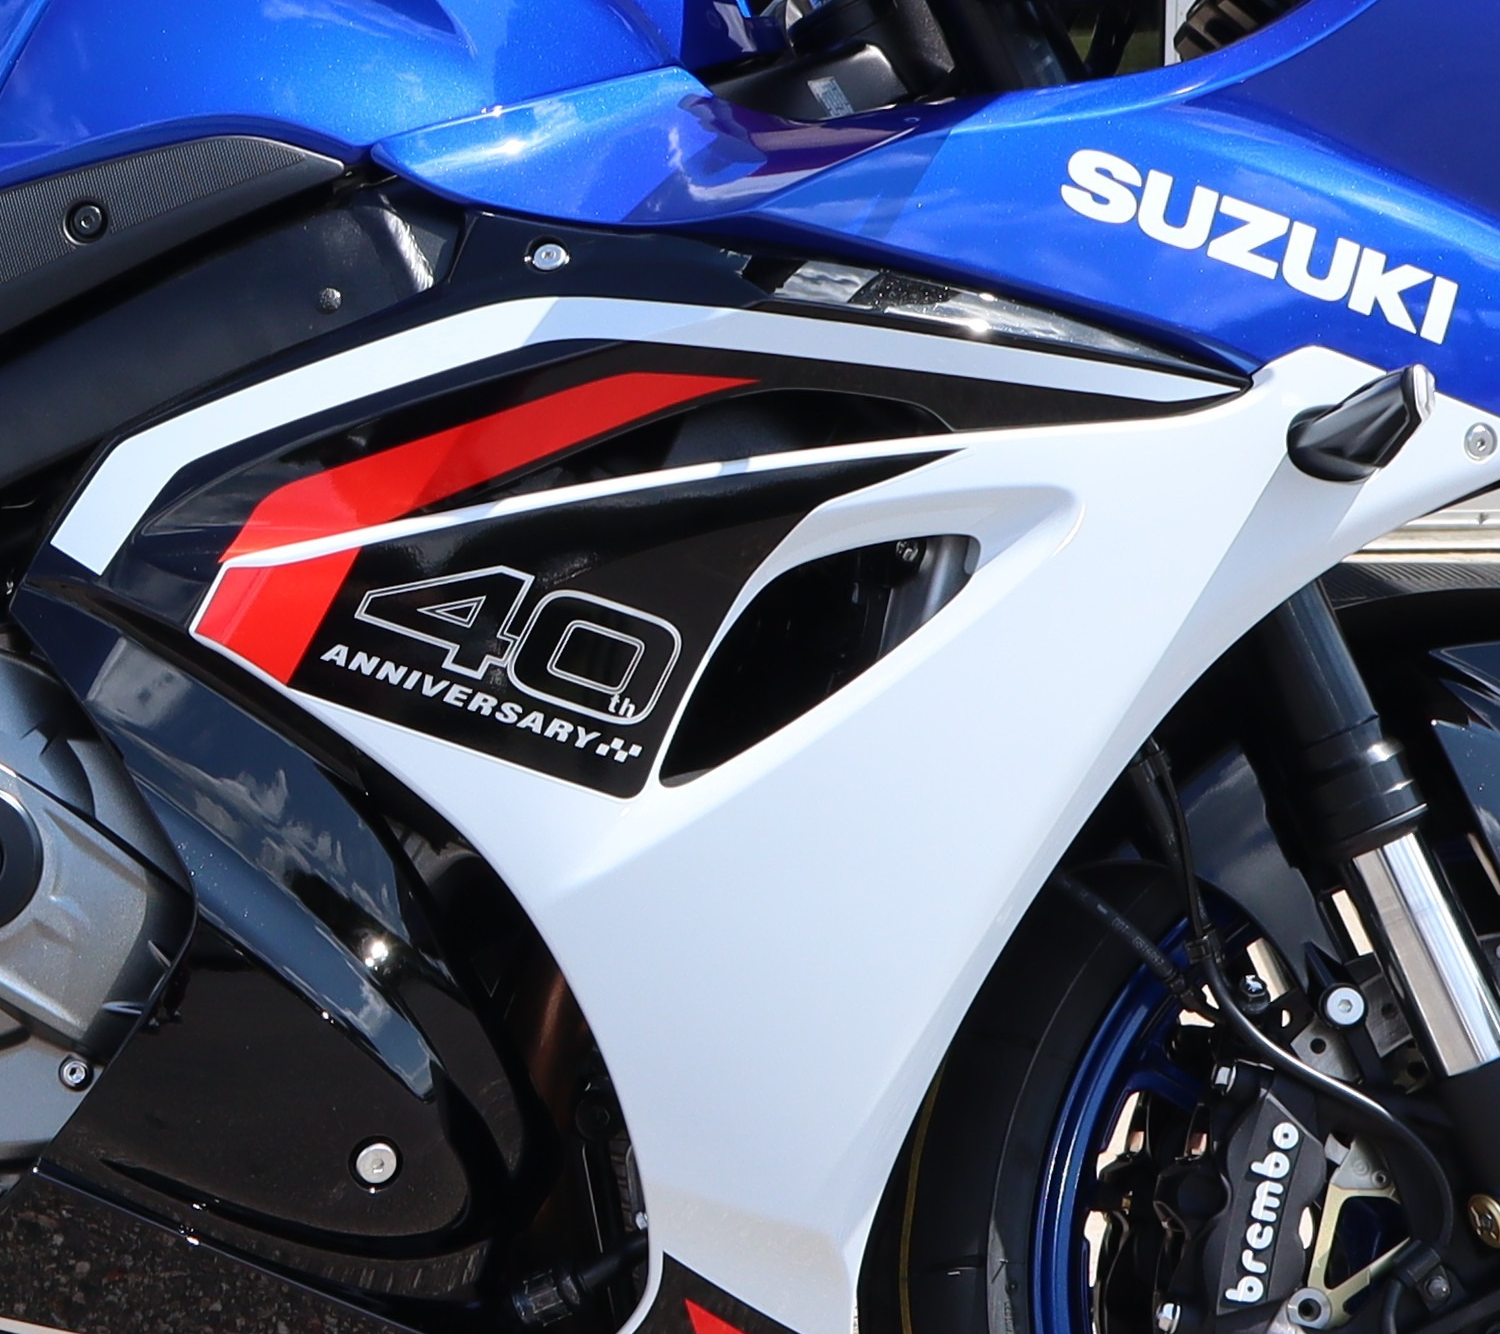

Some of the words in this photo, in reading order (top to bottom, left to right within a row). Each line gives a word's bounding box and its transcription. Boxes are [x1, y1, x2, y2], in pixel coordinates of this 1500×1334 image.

[1060, 148, 1459, 345] SUZUKI
[319, 643, 602, 750] ANNIVERSARY
[354, 565, 683, 726] 40
[607, 693, 637, 719] th
[1224, 1121, 1300, 1305] brembo
